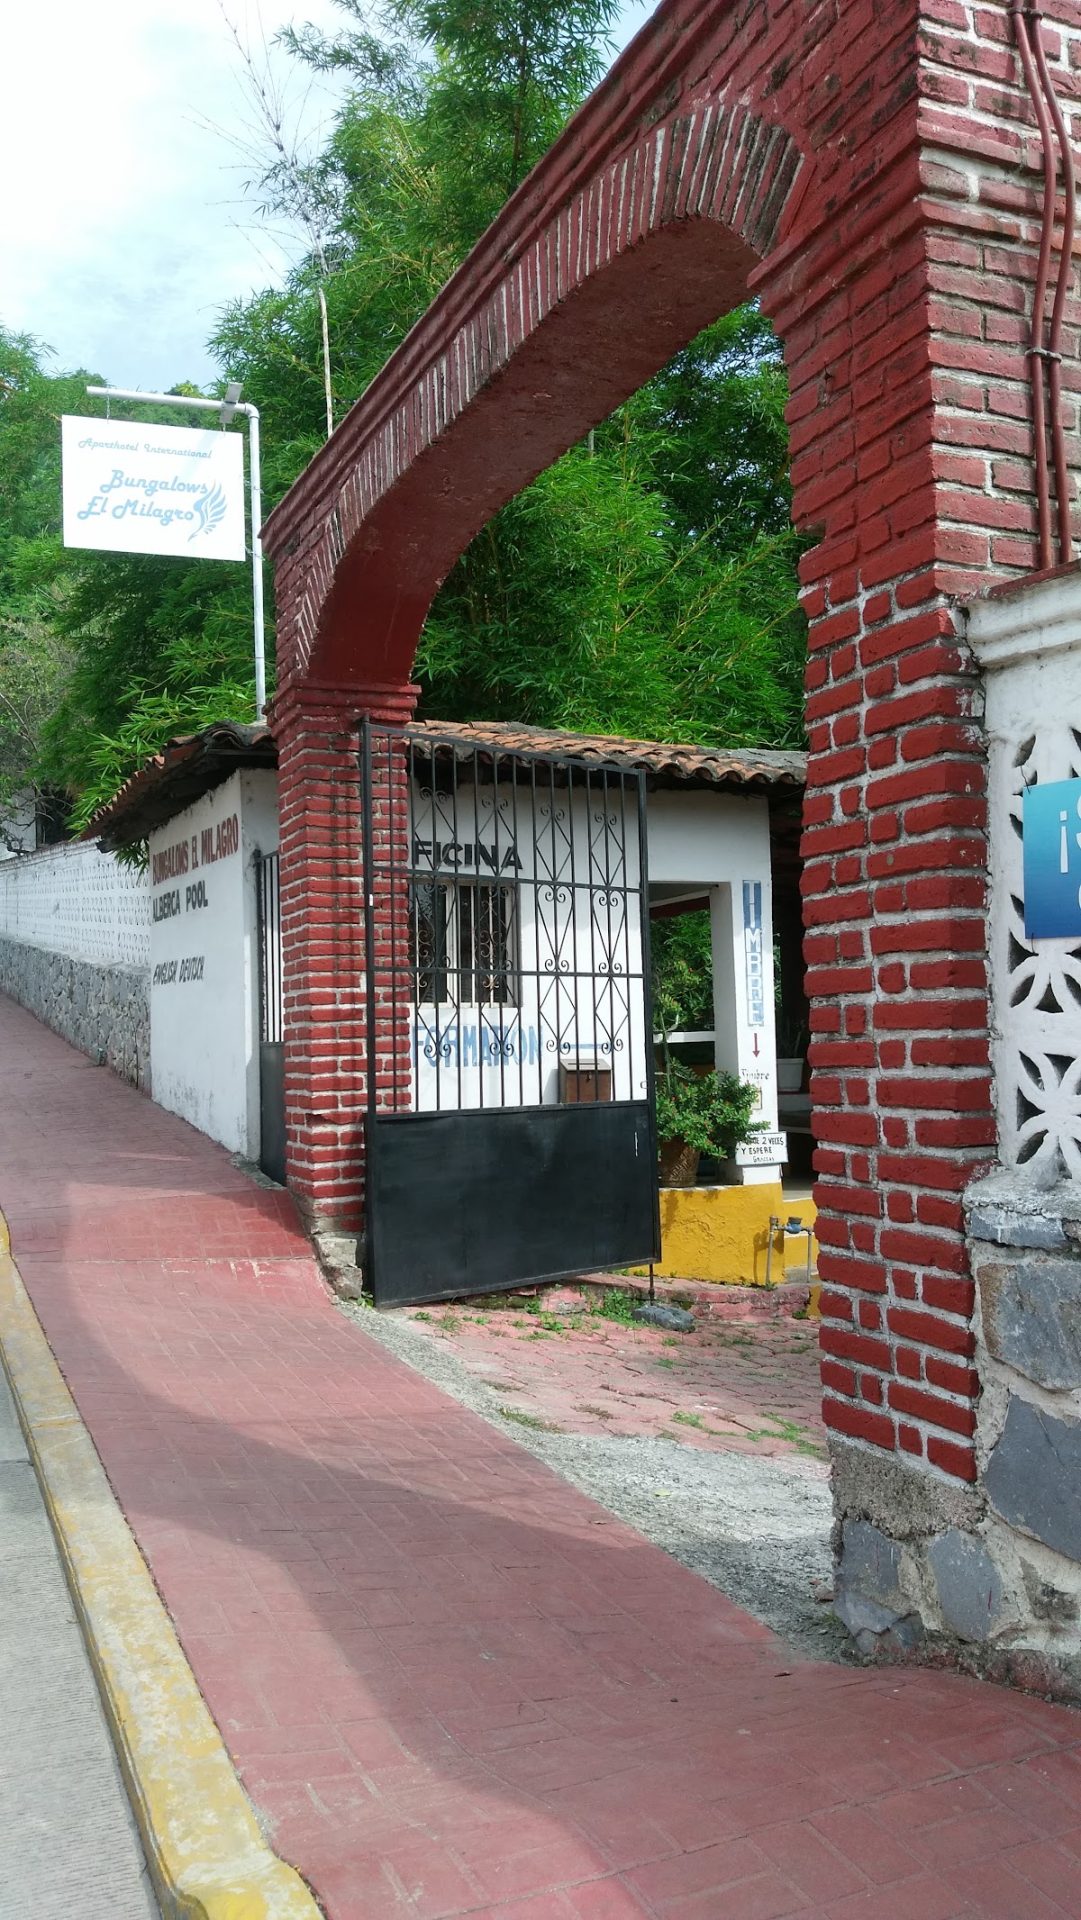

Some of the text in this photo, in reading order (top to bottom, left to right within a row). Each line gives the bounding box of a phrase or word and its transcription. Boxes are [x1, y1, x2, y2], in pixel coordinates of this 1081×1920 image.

[78, 438, 212, 458] Aparthotel International
[99, 469, 208, 497] Bungalows
[77, 496, 194, 526] El Milagro
[153, 813, 238, 886] BUNGALOWS EL MILAGRO
[406, 840, 523, 870] FICINA
[153, 880, 208, 922] ALBERCA POOL
[741, 1147, 747, 1155] Y
[762, 1137, 767, 1145] 2
